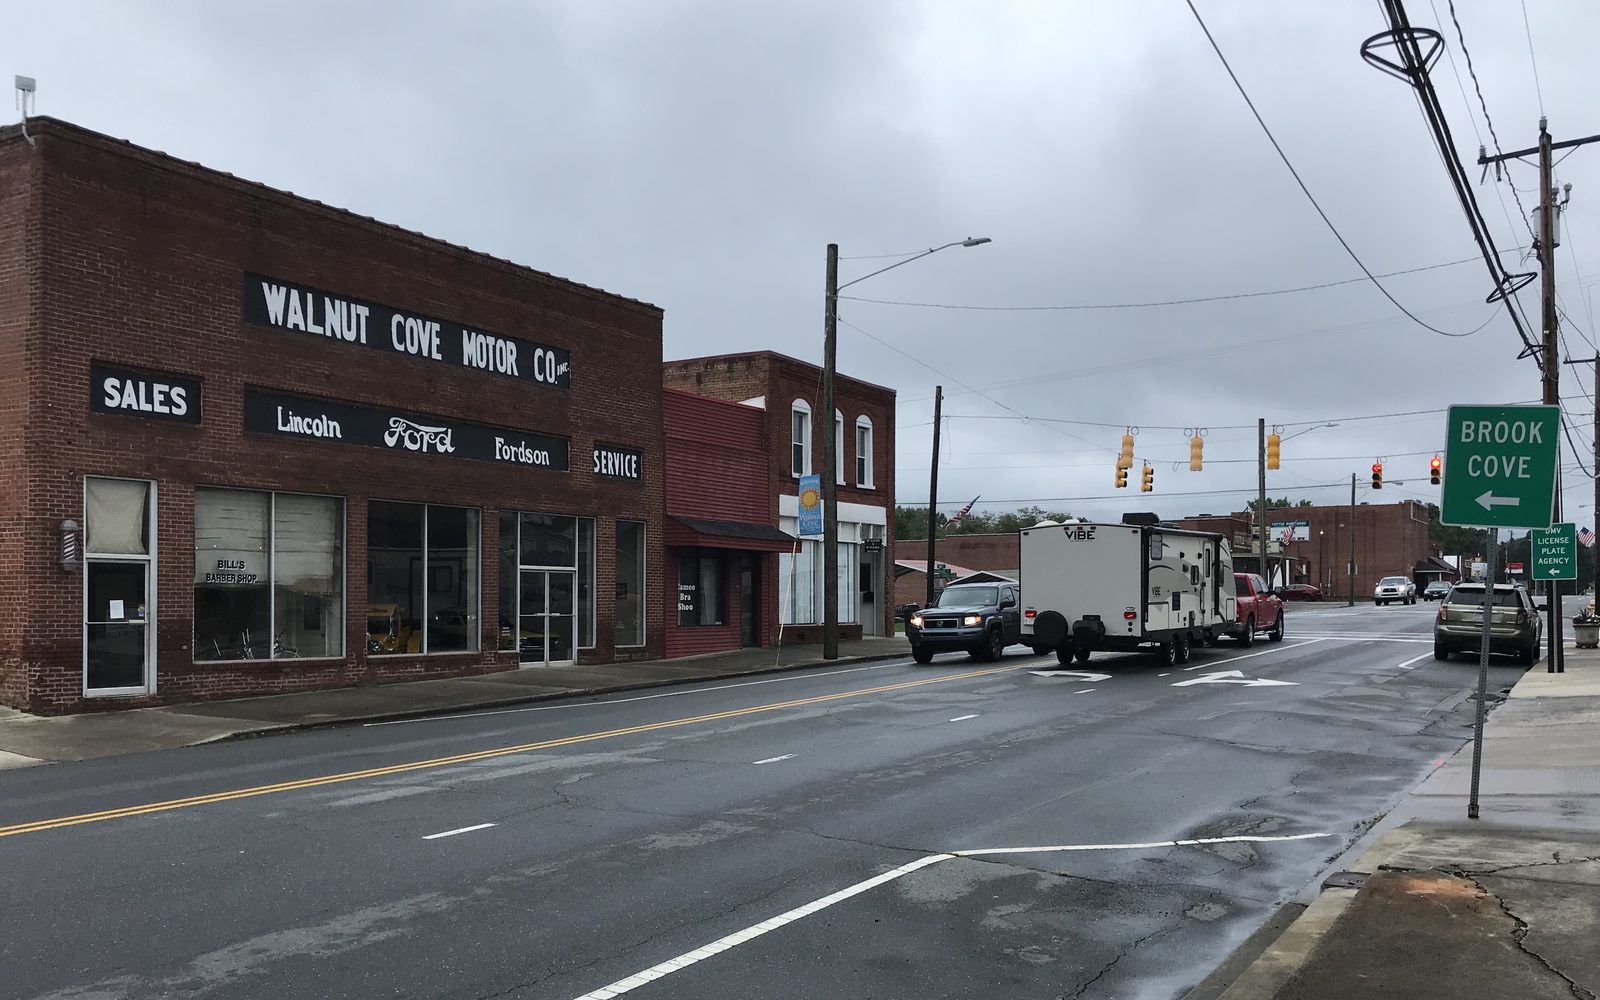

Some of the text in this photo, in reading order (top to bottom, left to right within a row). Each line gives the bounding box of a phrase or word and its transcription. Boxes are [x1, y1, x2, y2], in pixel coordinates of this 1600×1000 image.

[261, 282, 370, 344] WALNUT
[391, 313, 442, 360] COVE
[462, 329, 519, 377] MOTOR
[533, 348, 558, 384] CO.
[103, 377, 187, 416] SALES
[277, 406, 550, 466] Lincoln Ford Fordson
[1461, 420, 1544, 444] BROOK
[593, 450, 638, 478] SERVICE
[1468, 455, 1531, 478] COVE
[1065, 530, 1096, 540] VIBE
[1545, 527, 1562, 535] DMV
[1537, 536, 1570, 545] LICENSE
[1541, 547, 1566, 555] PLATE
[217, 560, 246, 570] BILL'S
[1537, 557, 1570, 565] AGENCY
[206, 573, 259, 584] BARBER SHOP
